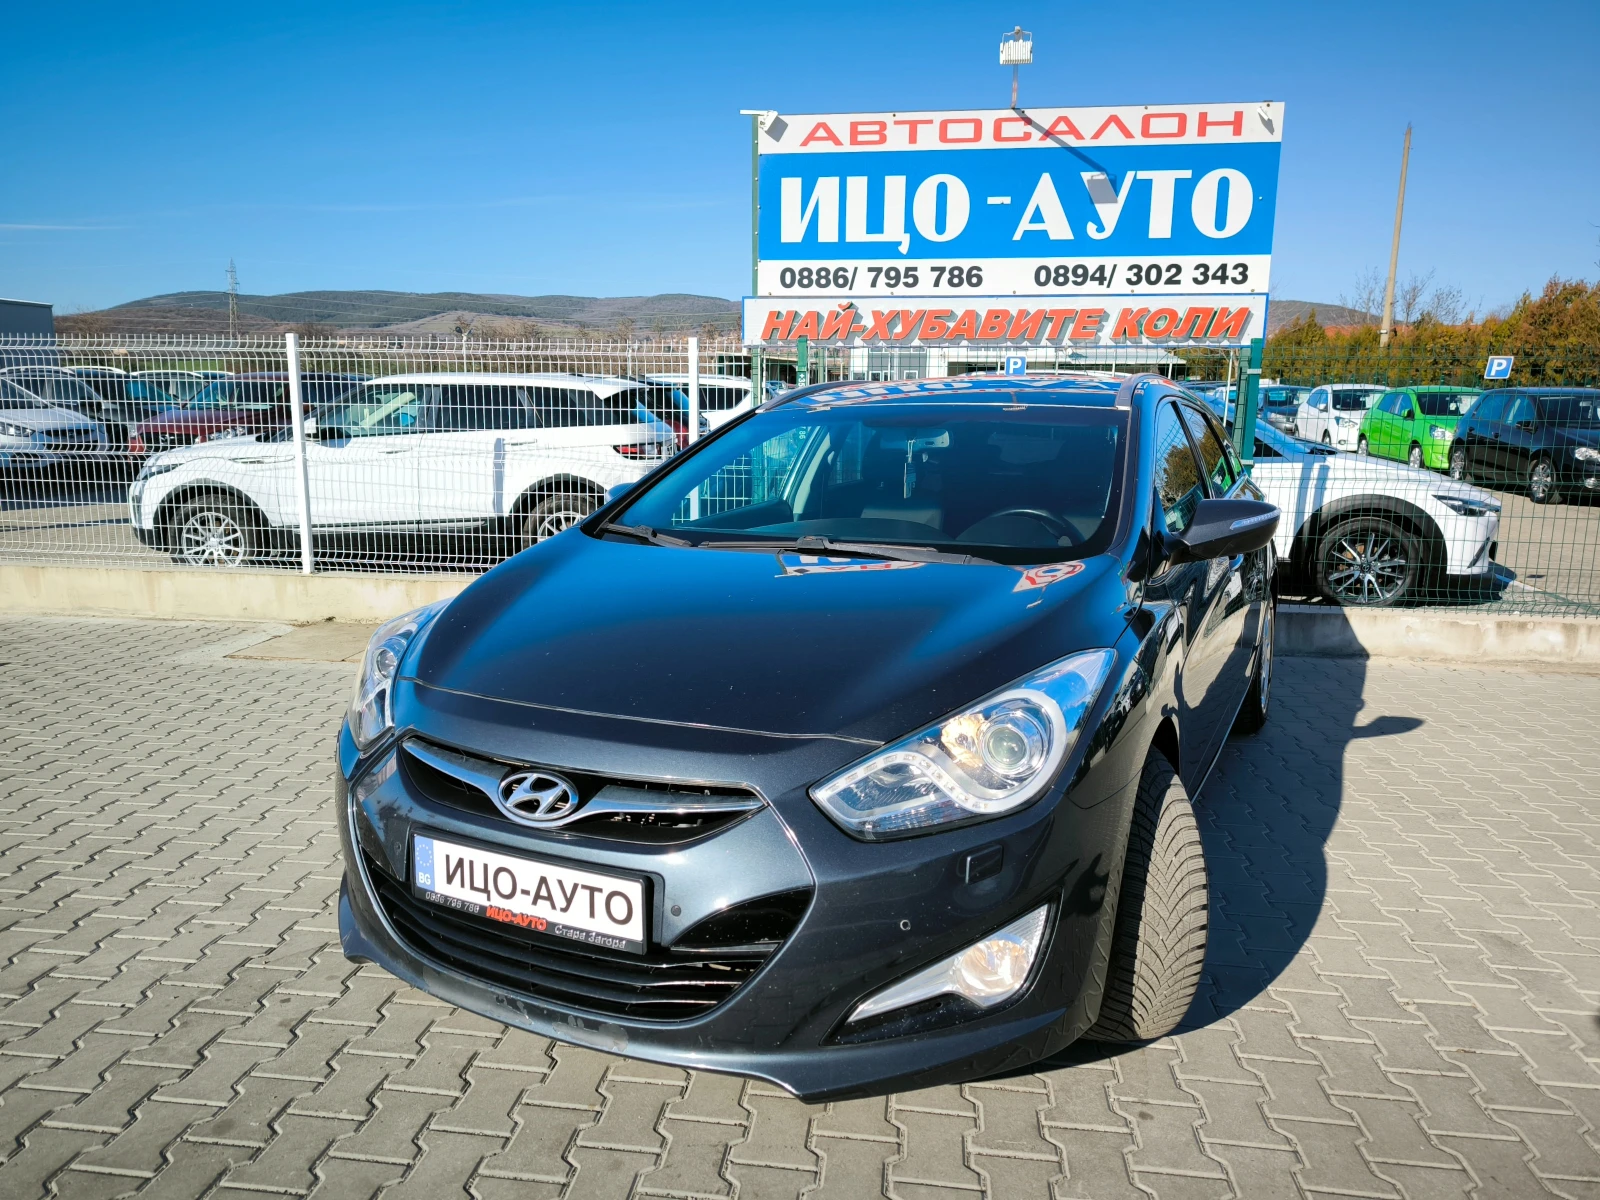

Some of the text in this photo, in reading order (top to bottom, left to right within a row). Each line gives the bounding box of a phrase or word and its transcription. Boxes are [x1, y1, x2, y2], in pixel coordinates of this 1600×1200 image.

[799, 110, 1243, 147] АВТОСАЛОН
[779, 265, 983, 290] 0886/ 795 786
[1034, 262, 1249, 288] 0894/ 302 343
[760, 301, 1250, 341] НАЙ-ХУБАВИТЕ КОЛИ
[1009, 358, 1022, 374] P
[1490, 359, 1507, 376] P
[418, 871, 431, 886] BG
[445, 854, 634, 926] ИЦО-АУТО
[447, 897, 462, 909] 795
[464, 902, 480, 914] 786
[486, 905, 548, 932] ИЦО-АУТО
[554, 924, 627, 949] Стара Загора
